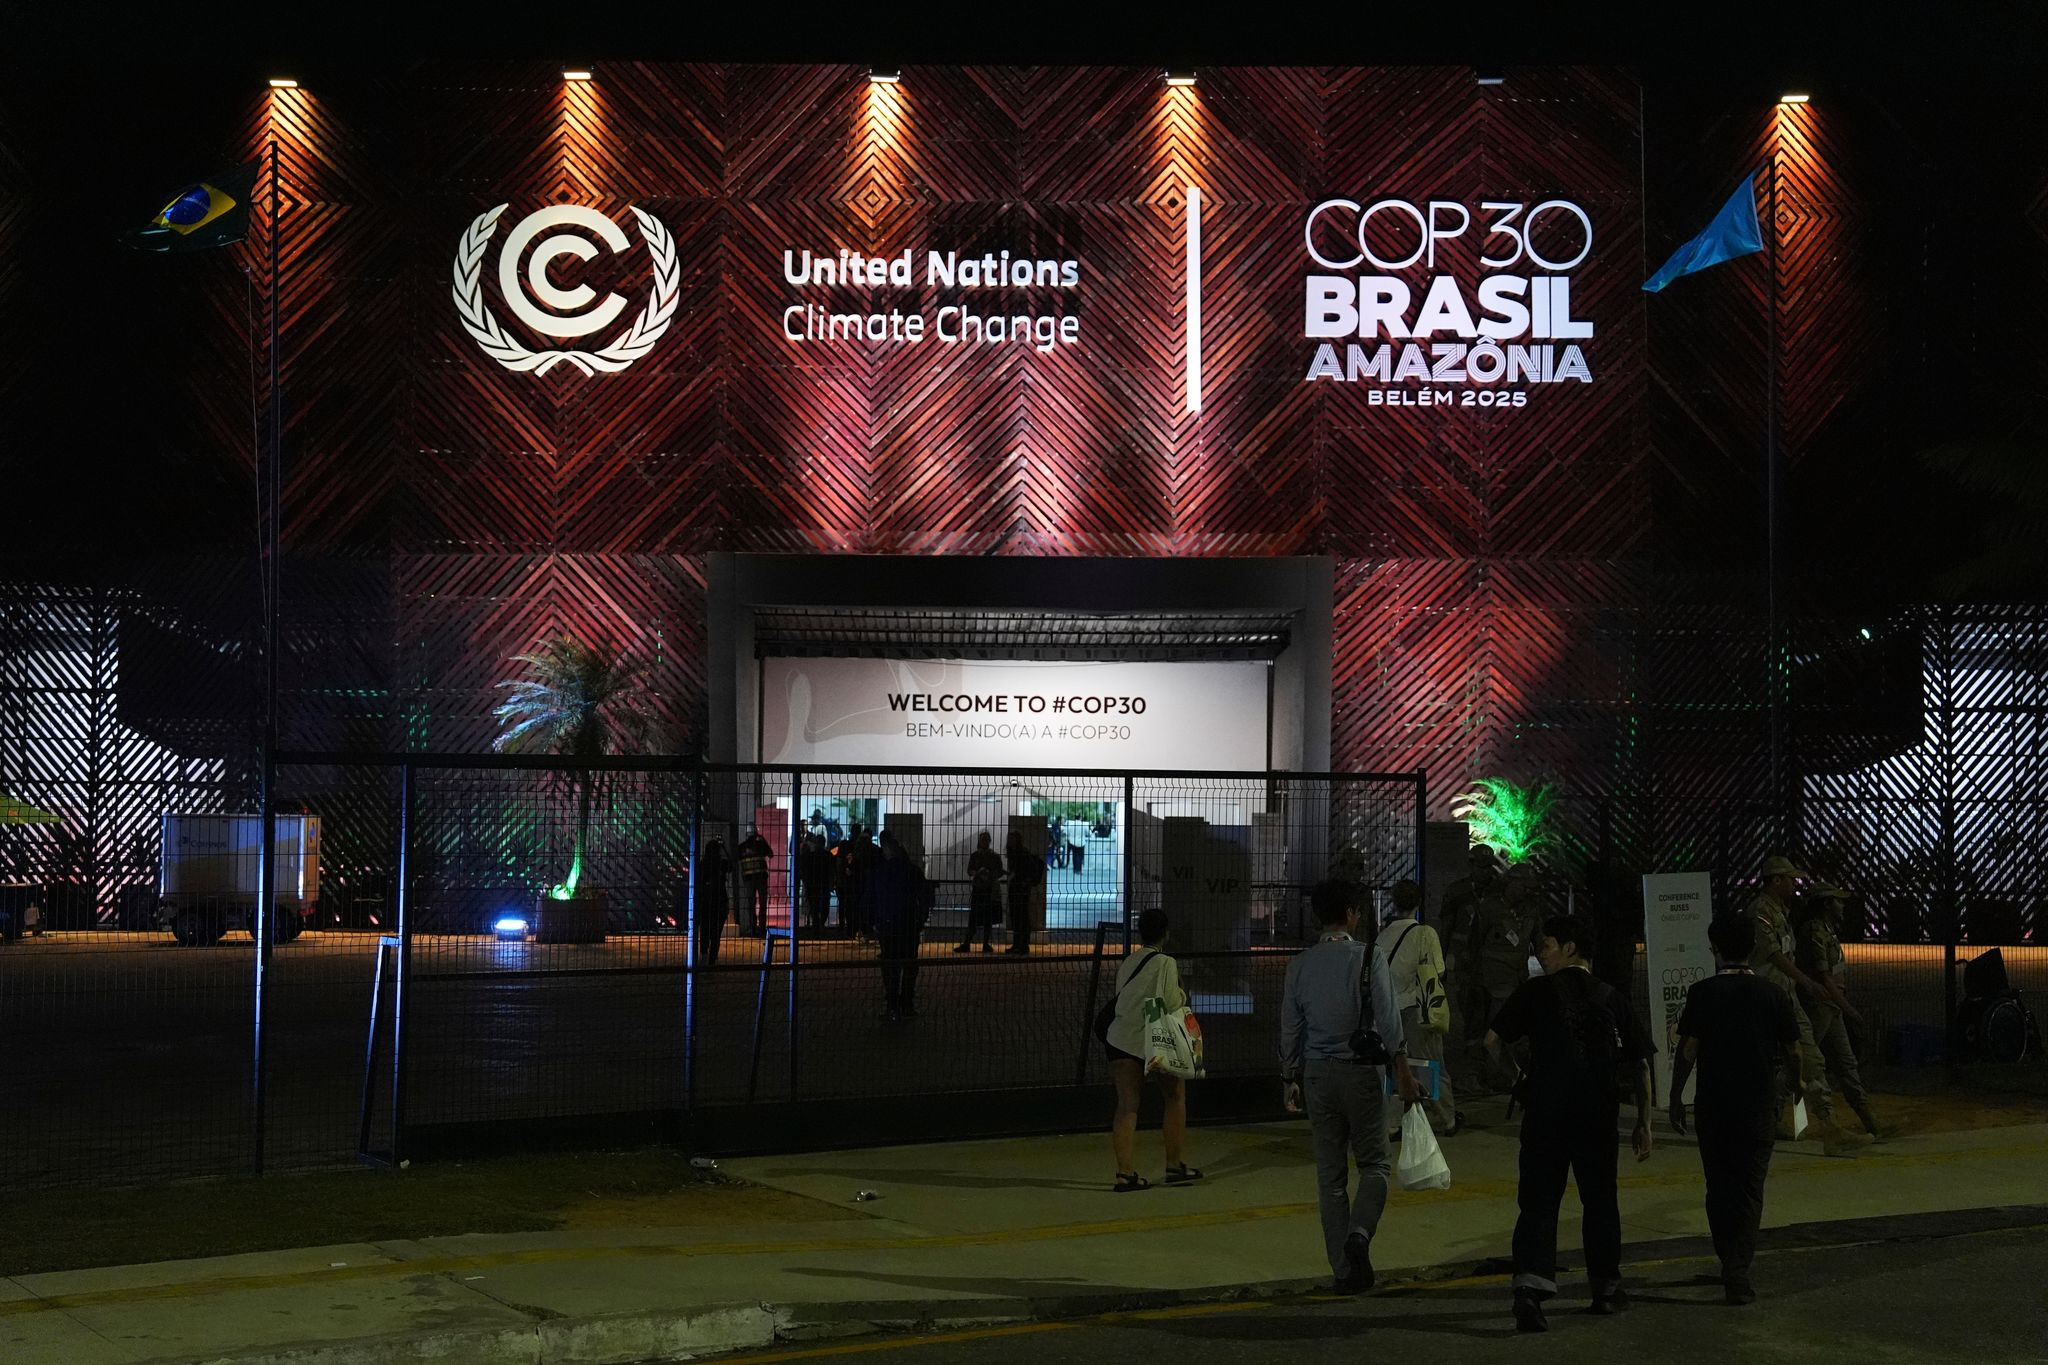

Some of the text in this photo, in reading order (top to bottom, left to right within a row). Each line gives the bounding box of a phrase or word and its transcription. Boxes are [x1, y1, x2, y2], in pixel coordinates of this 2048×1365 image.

[783, 248, 1079, 287] United Nations
[1305, 275, 1594, 339] BRASIL
[783, 303, 1080, 352] Climate Change
[1305, 336, 1593, 384] AMAZÔNIA
[1368, 387, 1528, 408] BELÉM 2025
[888, 693, 1147, 715] WELCOME TO #COP30
[906, 722, 1131, 741] BEM-VINDO(A) A #COP30
[1172, 866, 1195, 880] VI
[1206, 878, 1239, 894] VIP
[1658, 892, 1700, 902] CONFERENCE
[1670, 903, 1690, 912] BUSES
[1661, 966, 1706, 985] COP30
[1663, 986, 1687, 1001] BRA
